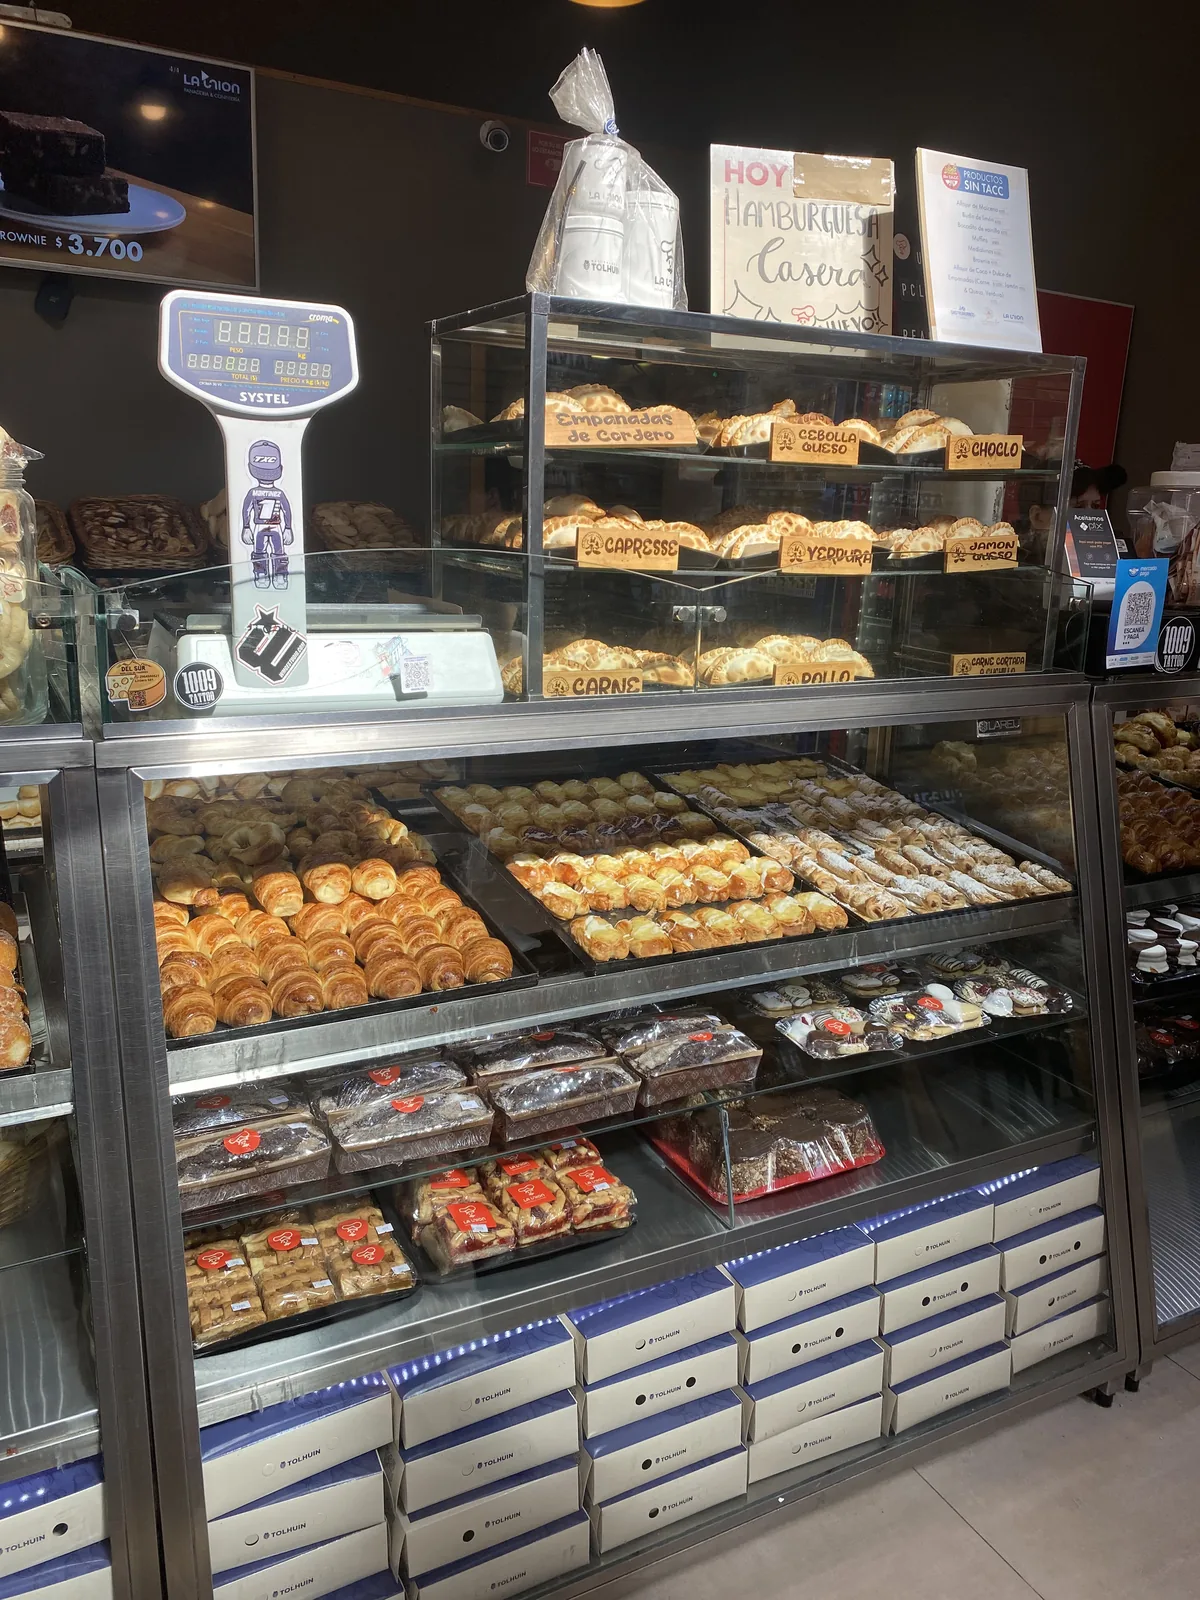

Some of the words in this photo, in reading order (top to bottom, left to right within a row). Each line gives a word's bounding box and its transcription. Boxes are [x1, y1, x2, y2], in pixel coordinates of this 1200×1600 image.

[183, 74, 199, 87] LA
[724, 159, 788, 188] HOY
[963, 169, 1004, 185] PRODUCTOS
[964, 179, 980, 192] SIN
[981, 183, 1004, 197] TACC
[724, 187, 879, 240] HAMBURGUESA
[0, 231, 47, 246] ROWNIE
[55, 236, 62, 248] $
[68, 234, 143, 262] 3.700
[746, 236, 872, 289] Casera
[654, 276, 665, 286] LA
[308, 313, 334, 324] croma
[231, 373, 249, 381] TOTAL
[240, 391, 289, 405] SYSTEL
[556, 413, 673, 427] Empanadas
[567, 429, 590, 443] de
[596, 429, 675, 443] Cordero
[798, 428, 857, 444] CEBOLLA
[802, 441, 847, 455] QUESO
[971, 441, 1019, 458] CHOCLO
[253, 455, 277, 463] TXC
[257, 498, 276, 520] 1
[1073, 514, 1104, 522] Aceitamos
[1088, 522, 1103, 530] pix
[604, 536, 678, 559] CAPRESSE
[969, 540, 1015, 551] JAMON
[807, 545, 872, 567] VERDURA
[1162, 625, 1192, 654] 1009
[972, 657, 994, 668] CARNE
[996, 656, 1025, 667] CORTADA
[1163, 654, 1185, 668] TATTOO
[181, 668, 218, 695] 1009
[572, 675, 640, 696] CARNE
[188, 690, 215, 705] TATTOO
[1042, 1201, 1062, 1213] TOLHUIN
[930, 1239, 951, 1251] TOLHUIN
[1052, 1248, 1071, 1260] TOLHUIN
[803, 1282, 827, 1295] TOLHUIN
[937, 1289, 957, 1301] TOLHUIN
[1060, 1288, 1077, 1301] TOLHUIN
[654, 1329, 680, 1344] TOLHUIN
[809, 1335, 832, 1348] TOLHUIN
[1056, 1333, 1074, 1346] TOLHUIN
[943, 1339, 963, 1352] TOLHUIN
[481, 1387, 511, 1403] TOLHUIN
[655, 1385, 682, 1399] TOLHUIN
[813, 1392, 836, 1406] TOLHUIN
[949, 1386, 970, 1399] TOLHUIN
[808, 1434, 832, 1448] TOLHUIN
[287, 1448, 321, 1467] TOLHUIN
[484, 1452, 514, 1468] TOLHUIN
[661, 1448, 687, 1463] TOLHUIN
[667, 1495, 693, 1511] TOLHUIN
[491, 1511, 521, 1527] TOLHUIN
[271, 1522, 307, 1538] TOLHUIN
[5, 1534, 46, 1553] TOLHUIN
[497, 1570, 527, 1588] TOLHUIN
[280, 1577, 314, 1596] TOLHUIN
